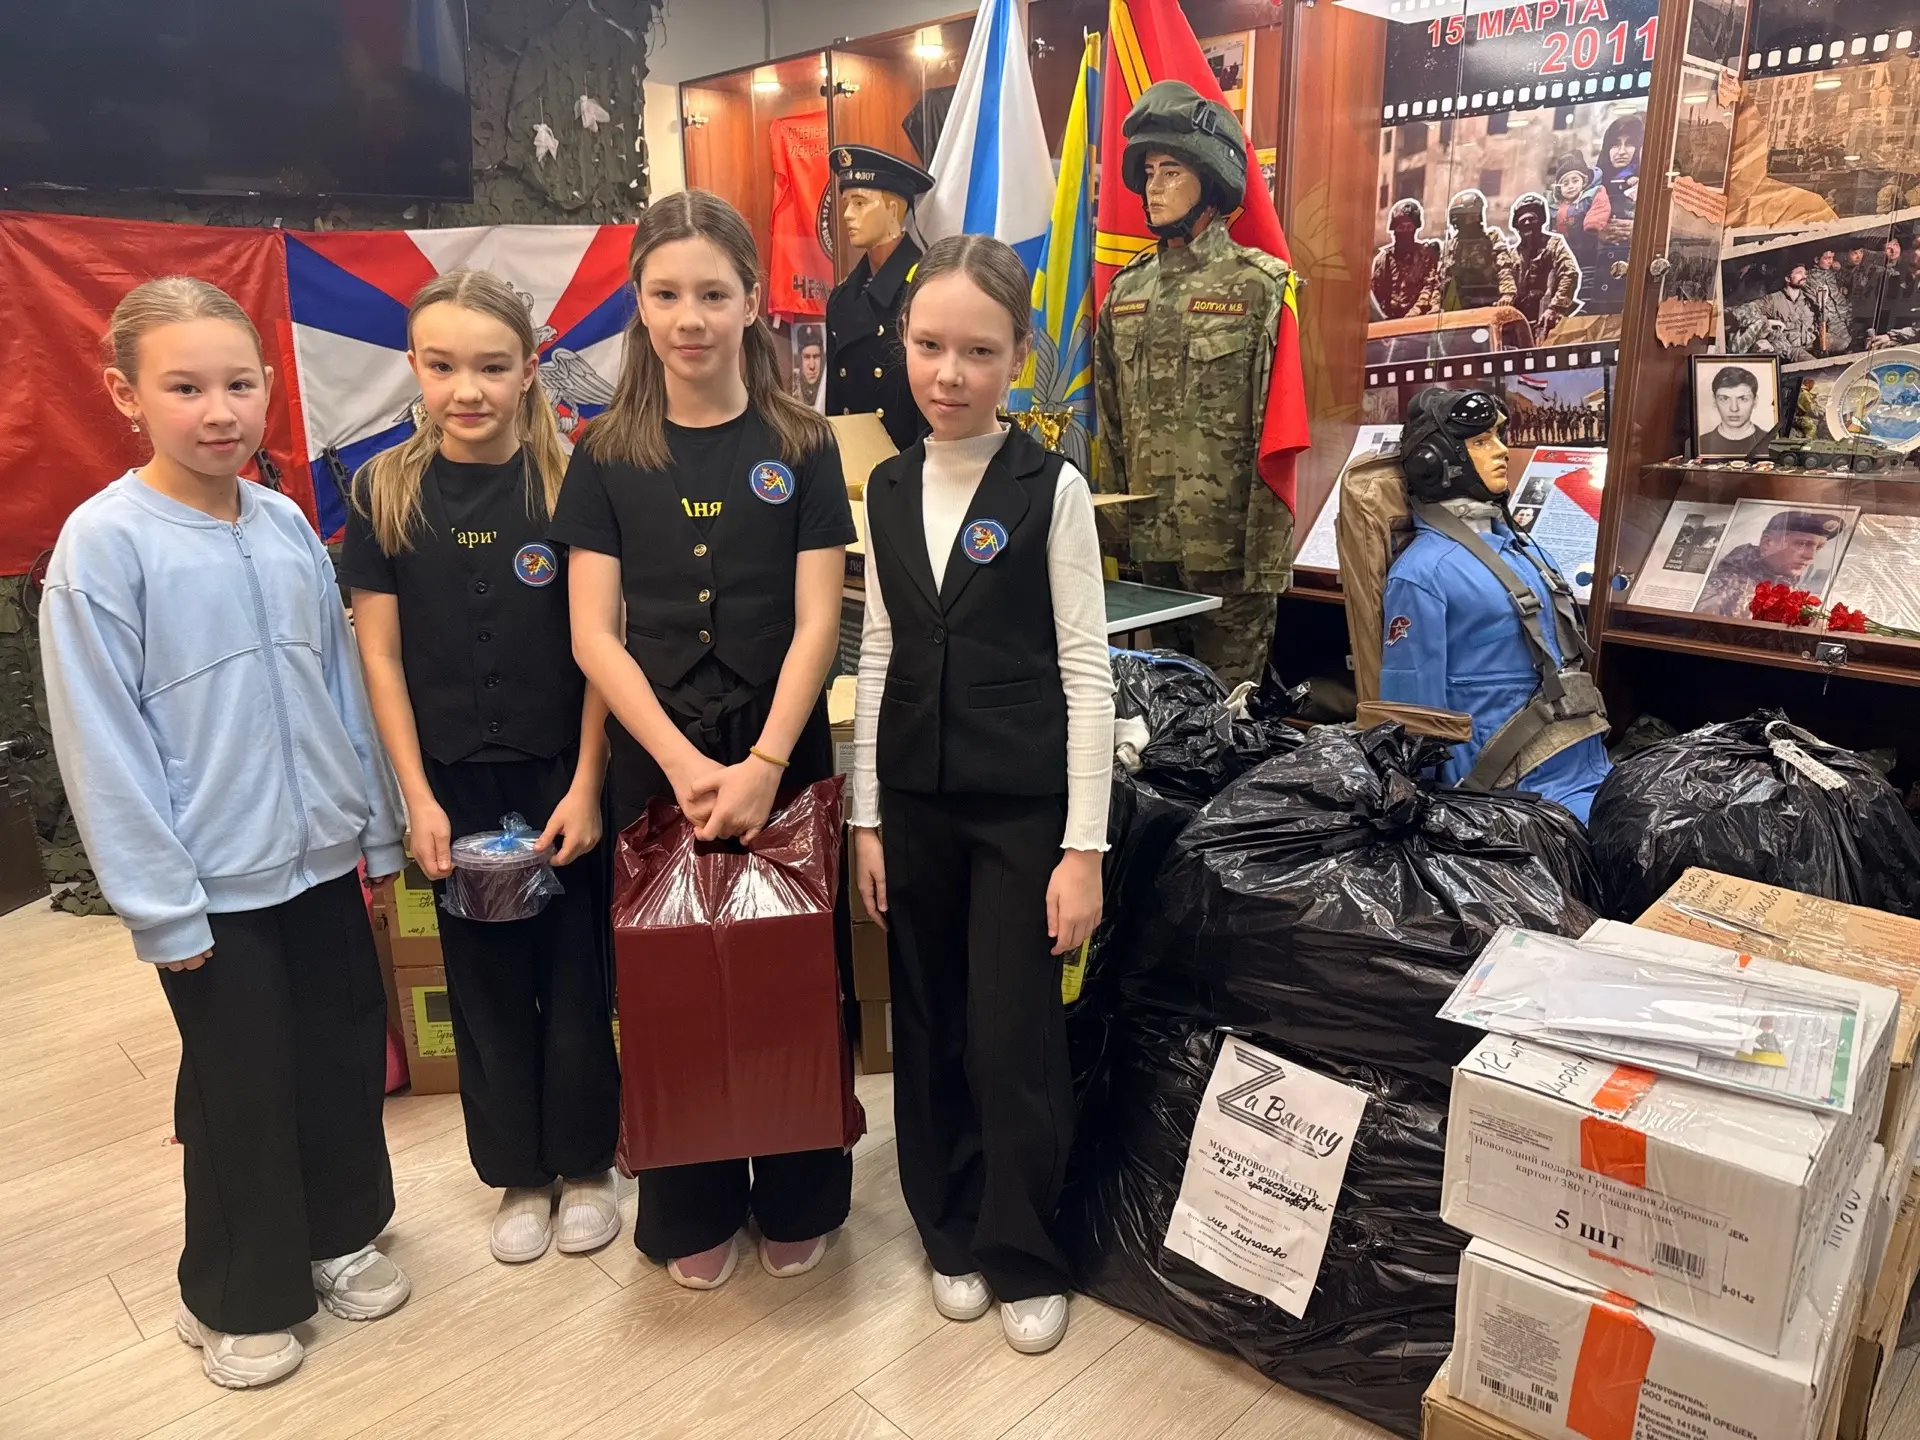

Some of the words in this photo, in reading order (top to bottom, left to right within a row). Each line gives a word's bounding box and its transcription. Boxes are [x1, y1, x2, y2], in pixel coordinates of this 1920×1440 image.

[1427, 15, 1465, 48] 15
[1477, 0, 1609, 40] МАРТА
[1539, 16, 1658, 76] 2011
[1193, 301, 1227, 312] ДОЛГИХ
[1229, 302, 1244, 312] М.В.
[451, 527, 497, 548] ари
[1474, 1050, 1512, 1074] 12
[1208, 1139, 1292, 1185] МАСКИРОВОЧНАЯ
[1293, 1180, 1320, 1198] СЕТЬ
[1474, 1135, 1538, 1165] Новогодний
[1540, 1157, 1585, 1181] подарок
[1588, 1175, 1656, 1207] Гринландия
[1659, 1199, 1719, 1229] Добрюша
[1515, 1163, 1551, 1182] картон
[1560, 1178, 1581, 1193] 380
[1598, 1192, 1675, 1227] Сладкополис
[1554, 1209, 1570, 1230] 5
[1579, 1222, 1624, 1249] шт
[1640, 1403, 1673, 1424] Россия,
[1643, 1378, 1708, 1409] Изготовитель:
[1638, 1411, 1691, 1439] Московская
[1642, 1388, 1662, 1402] ООО
[1663, 1397, 1712, 1423] «СЛАДКИЙ
[1713, 1417, 1758, 1440] ОРЕШЕК»
